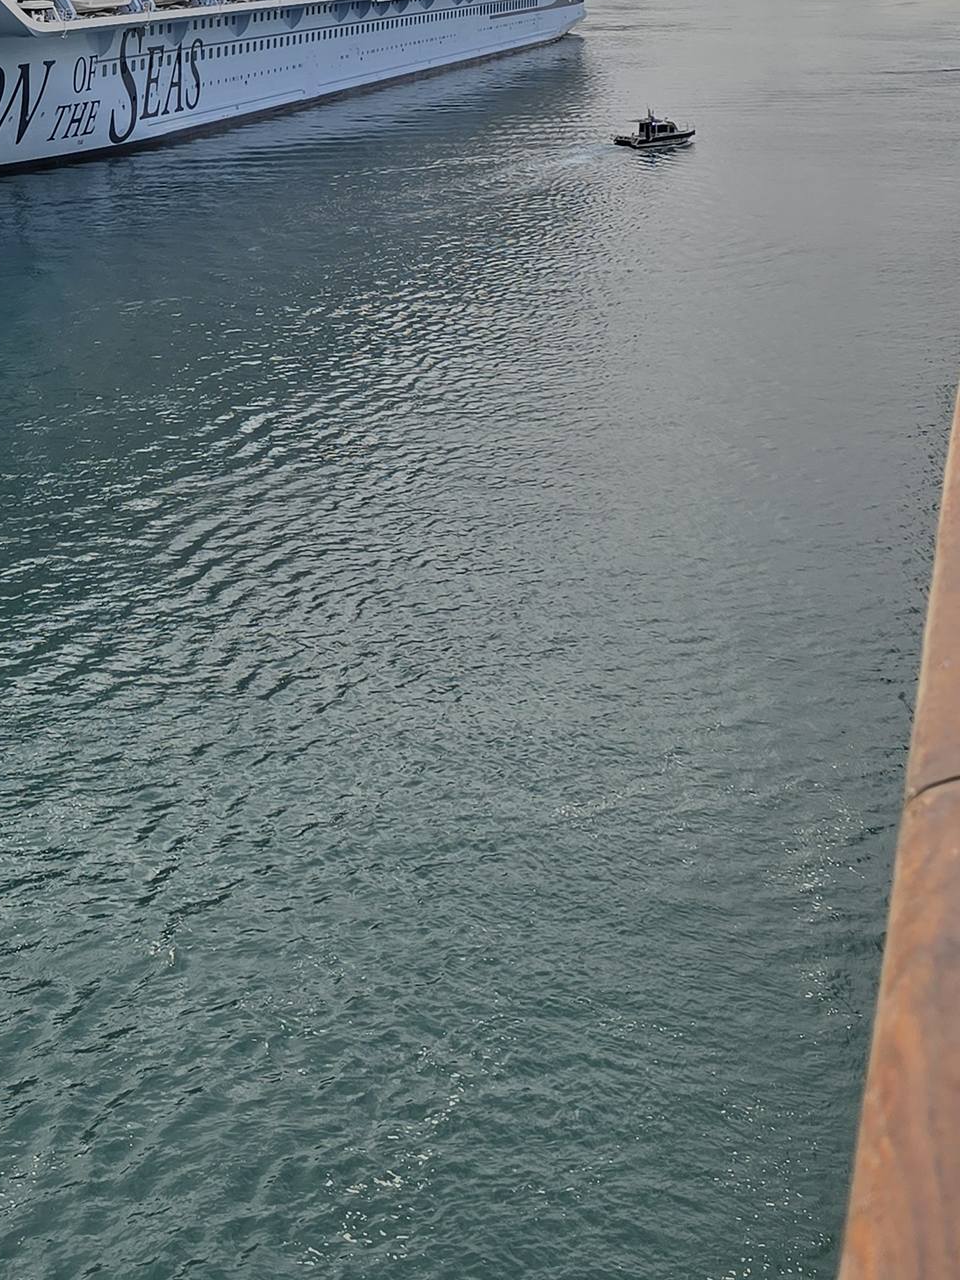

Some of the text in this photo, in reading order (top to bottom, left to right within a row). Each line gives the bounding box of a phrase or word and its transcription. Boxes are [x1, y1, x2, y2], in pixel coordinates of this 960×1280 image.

[73, 55, 99, 94] OF
[108, 28, 204, 144] SEAS
[47, 100, 100, 142] THE
